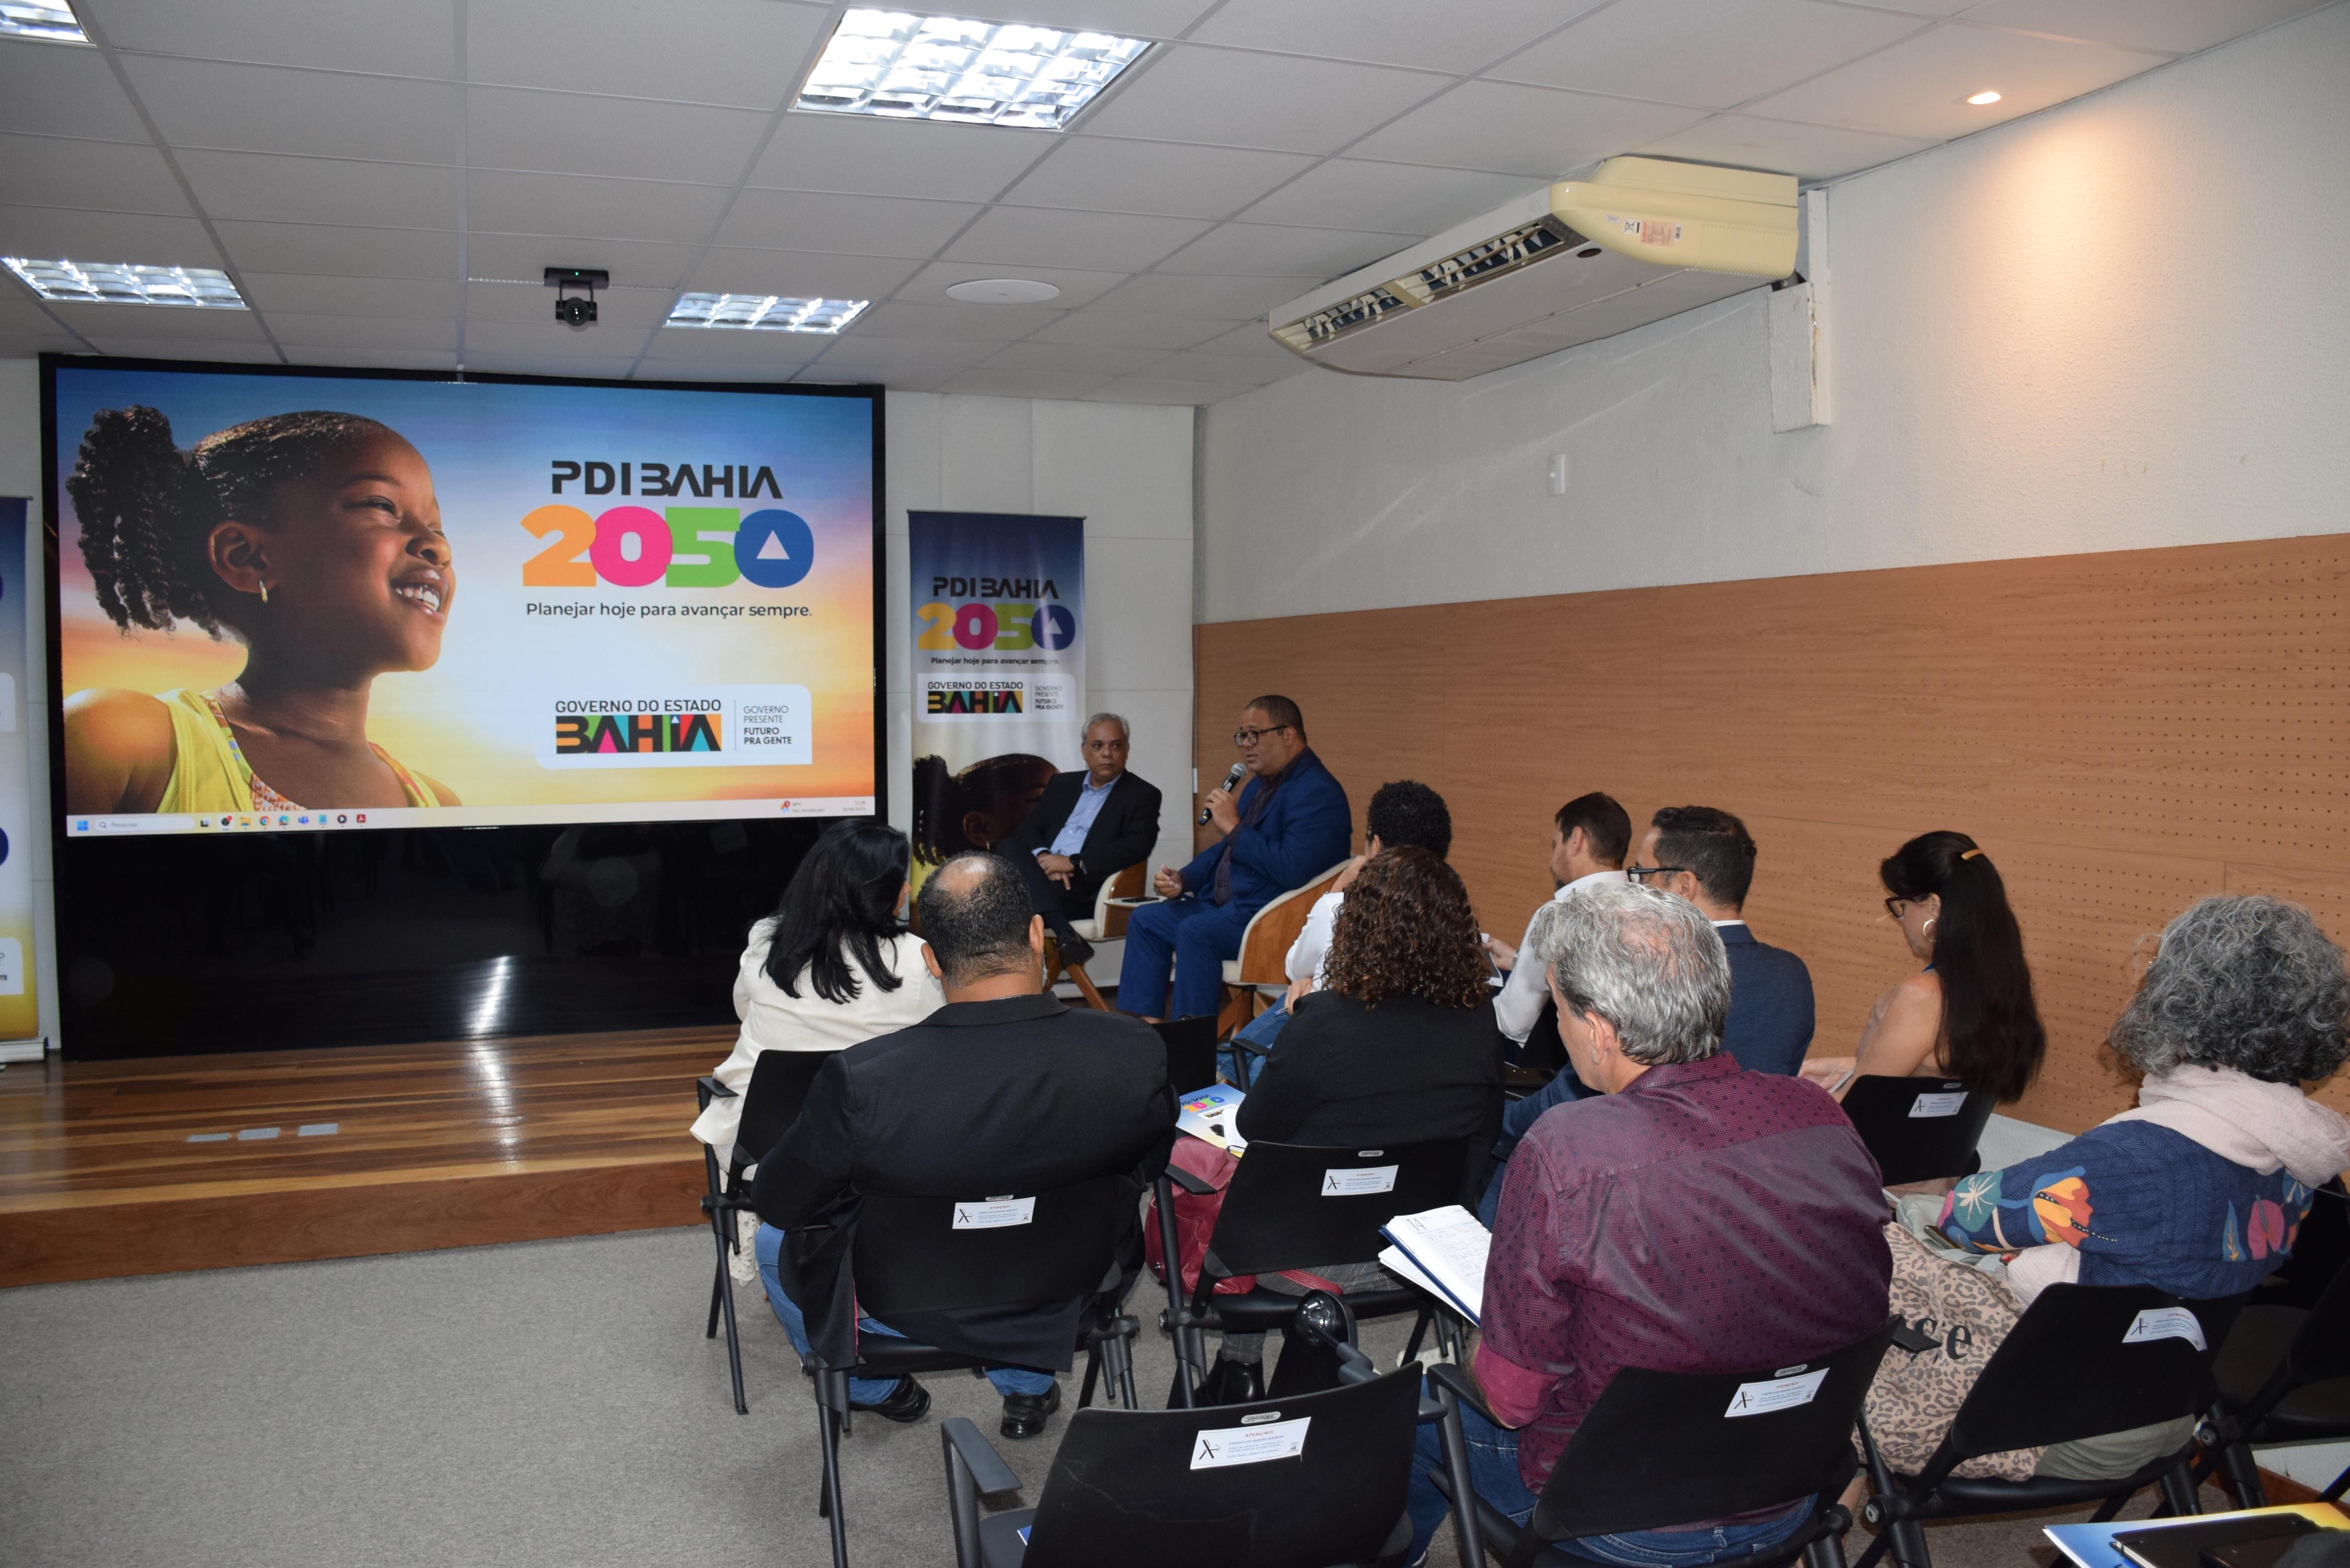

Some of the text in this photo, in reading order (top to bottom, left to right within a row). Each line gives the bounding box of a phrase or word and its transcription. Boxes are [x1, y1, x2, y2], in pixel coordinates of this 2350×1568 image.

[552, 460, 784, 499] PDI BAHIA
[520, 504, 814, 589] 2050
[933, 577, 1059, 599] PDI BAHIA
[526, 602, 812, 619] Planejar hoje para avançar sempre.
[917, 602, 1076, 651] 2050
[930, 657, 962, 666] Planejar
[963, 657, 980, 666] hoje
[1000, 658, 1029, 666] avançar
[928, 682, 972, 690] GOVERNO
[556, 699, 721, 713] GOVERNO DO ESTADO
[743, 705, 789, 714] GOVERNO
[927, 690, 1023, 714] BAHIA
[744, 714, 784, 723] PRESENTE
[556, 714, 722, 754] BAHIA
[744, 727, 780, 735] FUTURO
[744, 736, 792, 745] PRA GENTE
